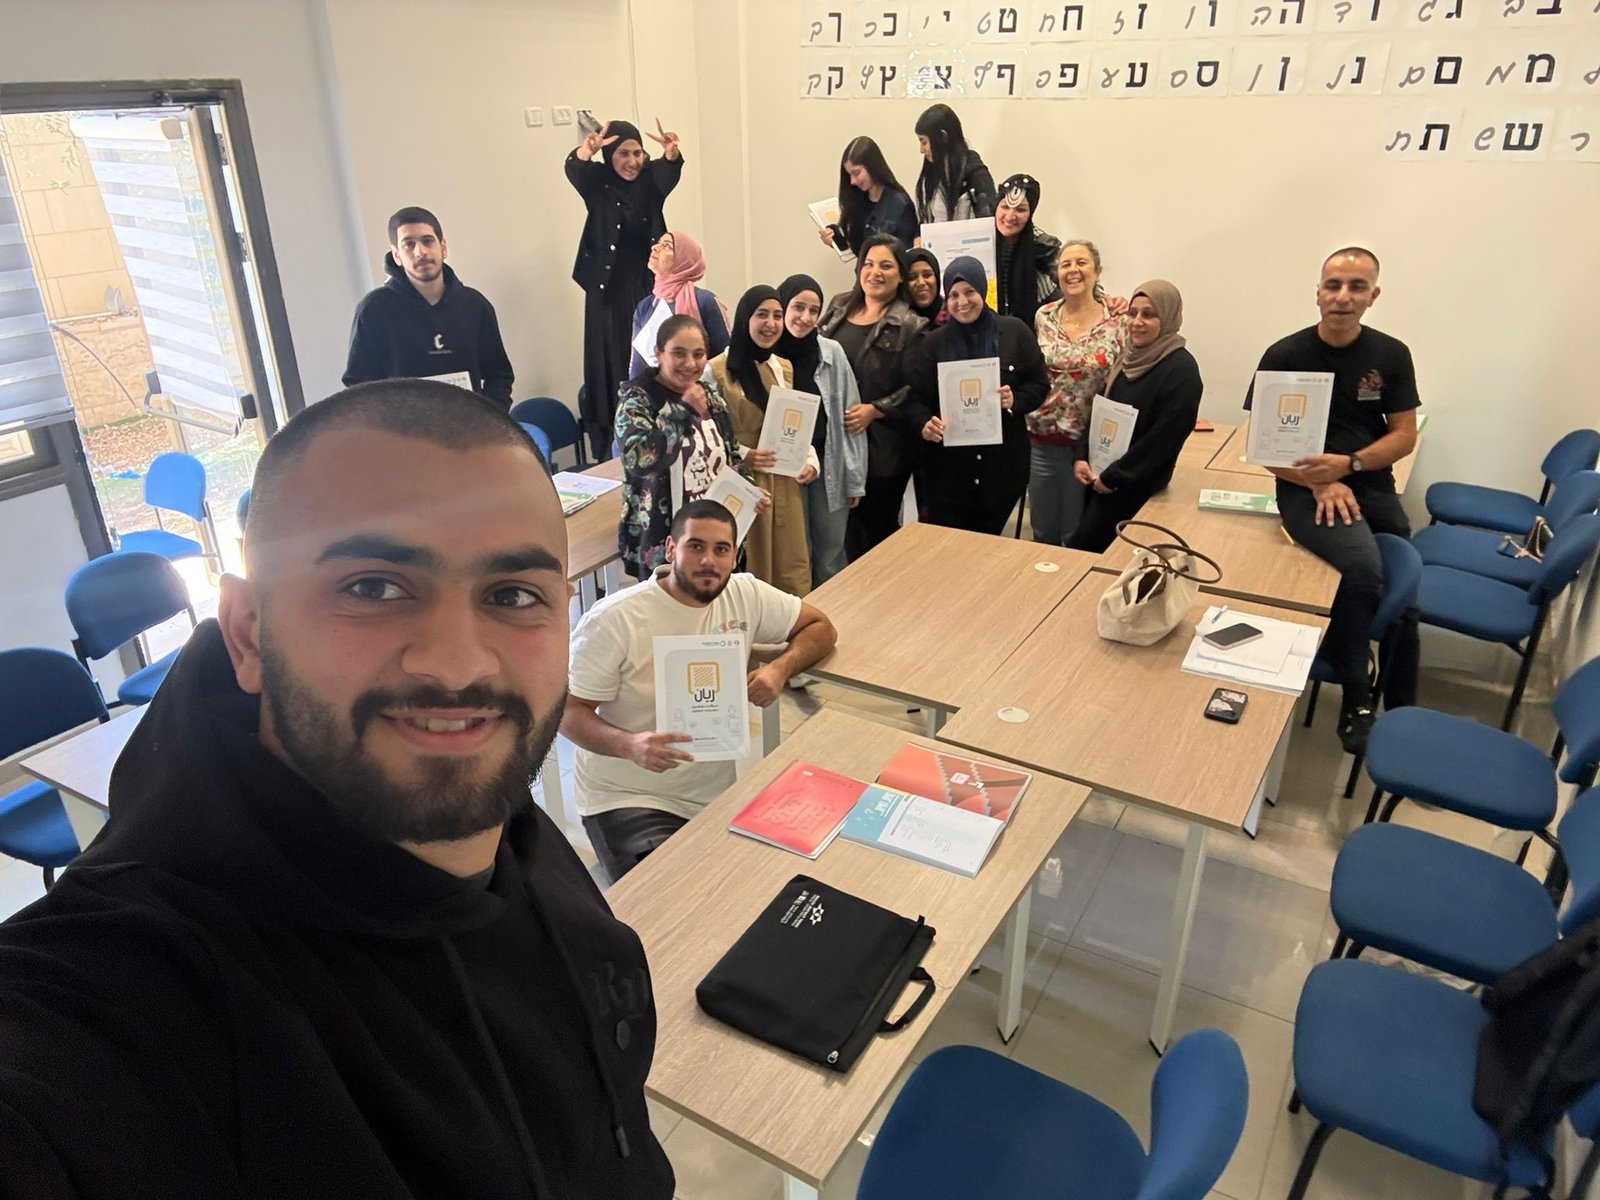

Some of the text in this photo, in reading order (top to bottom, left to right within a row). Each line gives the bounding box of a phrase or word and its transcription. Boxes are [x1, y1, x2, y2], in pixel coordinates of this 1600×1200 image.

[883, 13, 897, 36] כ
[943, 11, 950, 22] י
[999, 8, 1017, 33] ט
[1063, 5, 1083, 31] ח
[1138, 4, 1147, 29] ז
[1209, 0, 1217, 26] ו
[1280, 0, 1305, 24] ה
[829, 13, 841, 42] ך
[828, 67, 843, 95] ק
[880, 66, 896, 95] ץ
[934, 66, 952, 89] צ
[997, 64, 1015, 95] ף
[1058, 64, 1079, 88] פ
[1126, 63, 1148, 87] ע
[1197, 61, 1219, 87] ס
[1279, 57, 1290, 91] ן
[1351, 57, 1366, 84] נ
[1434, 57, 1462, 84] ם
[1525, 54, 1555, 83] מ
[1419, 124, 1450, 150] ת
[1503, 123, 1543, 151] ש
